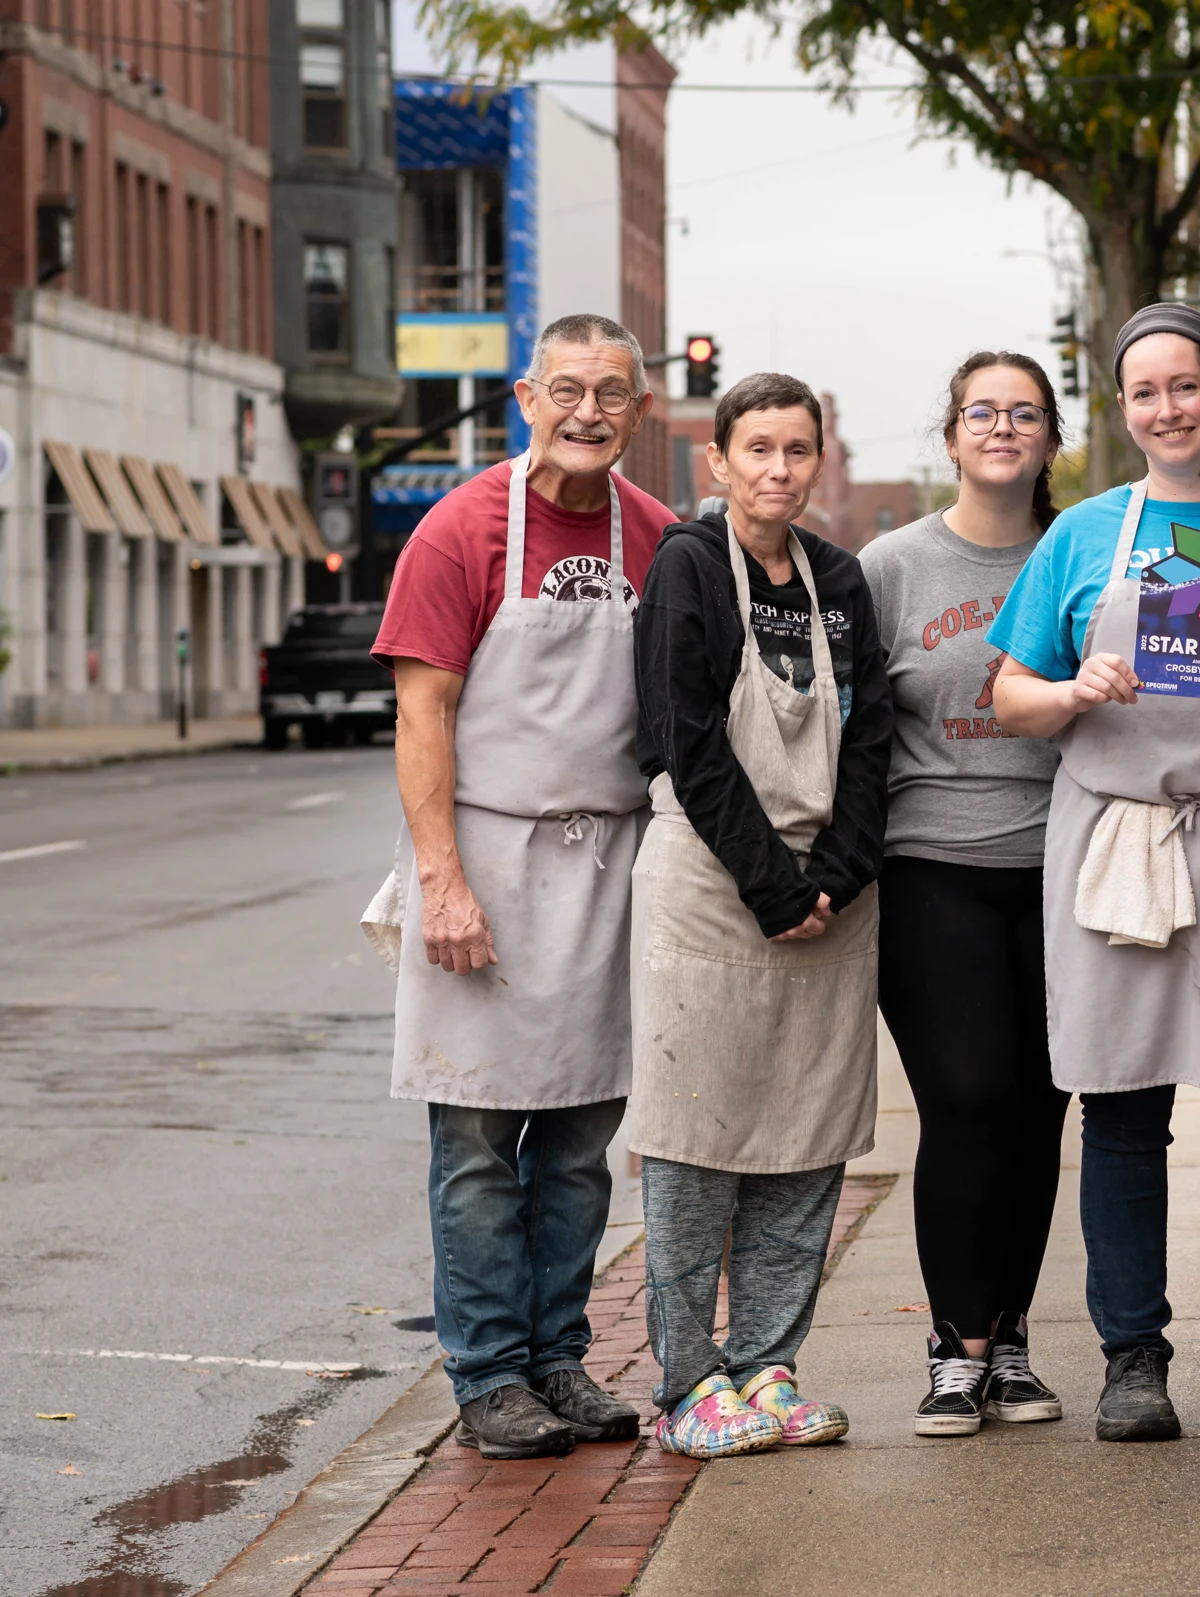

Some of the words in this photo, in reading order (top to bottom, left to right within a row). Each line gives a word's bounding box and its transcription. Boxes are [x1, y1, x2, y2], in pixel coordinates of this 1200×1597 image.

[540, 558, 635, 604] LACONA
[748, 602, 777, 617] TCH
[784, 610, 845, 624] EXPESS
[1148, 635, 1198, 656] STAR
[1145, 681, 1178, 690] SPECTRUM
[942, 717, 1019, 740] TRAC
